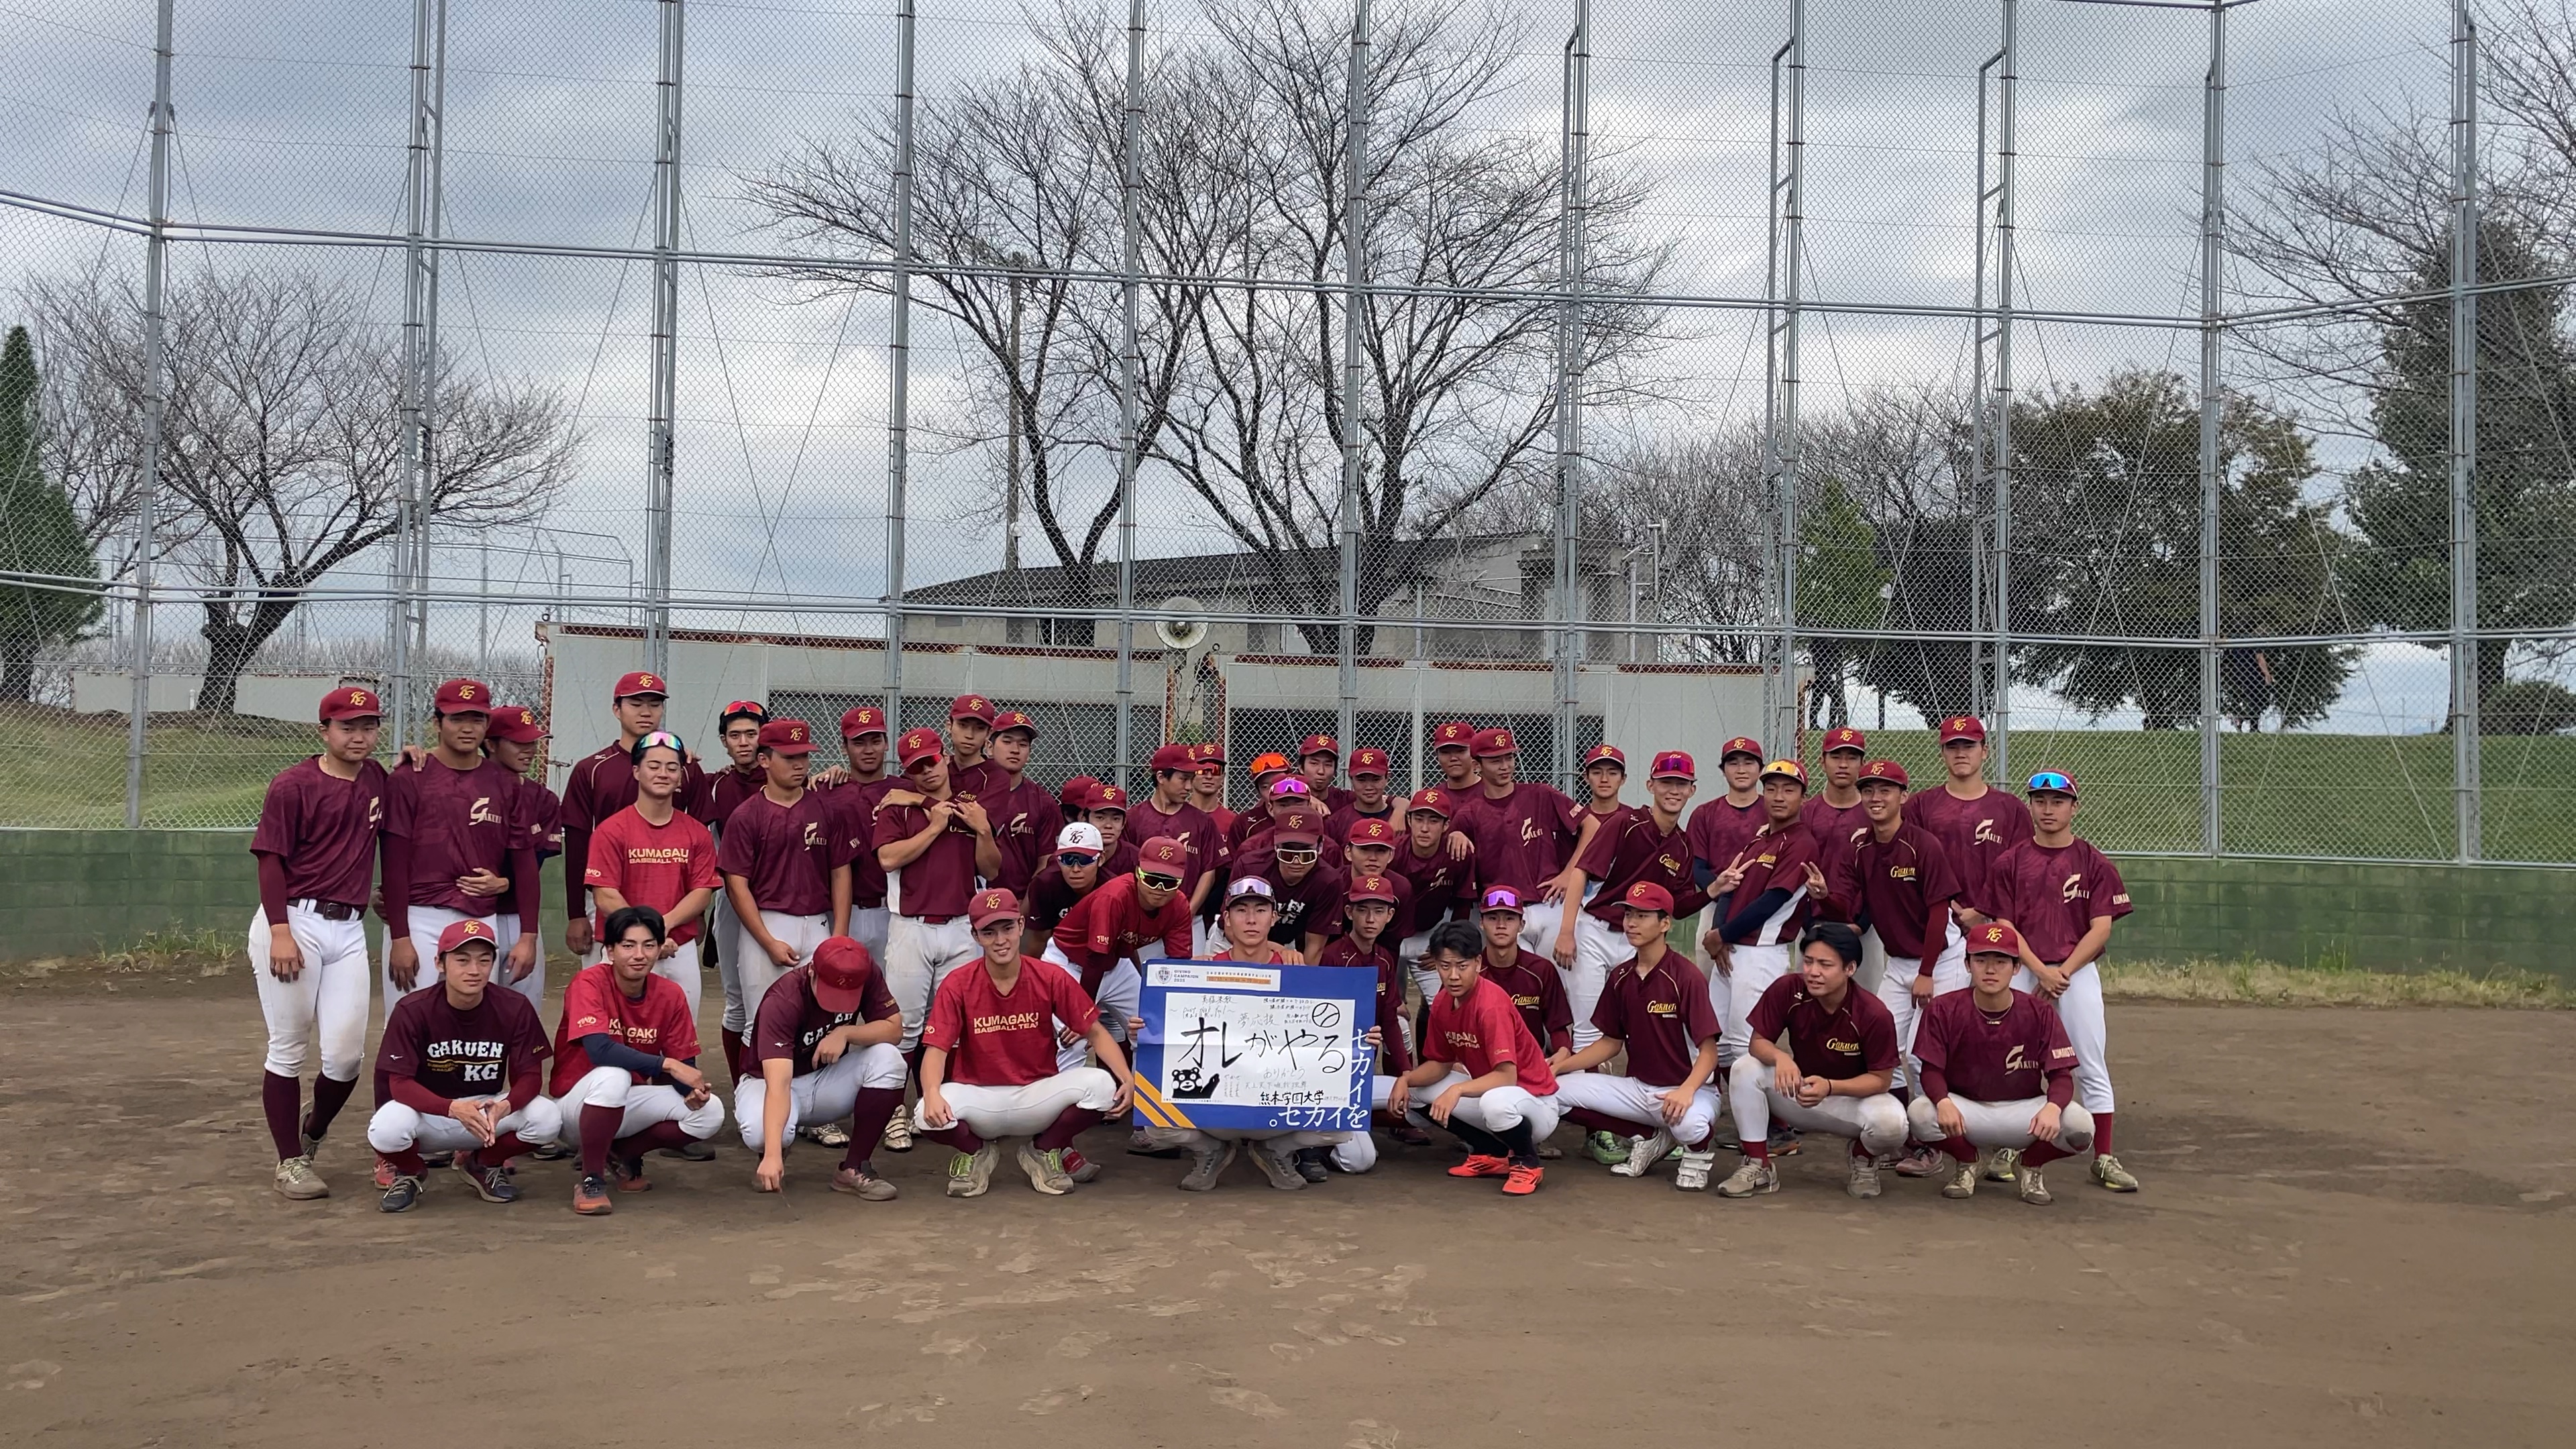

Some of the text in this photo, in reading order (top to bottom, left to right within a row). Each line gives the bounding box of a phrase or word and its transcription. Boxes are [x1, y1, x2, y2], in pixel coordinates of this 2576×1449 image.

[640, 674, 653, 688] KG
[350, 691, 367, 706] KG
[460, 685, 475, 700] KG
[969, 699, 983, 711] KG
[858, 710, 871, 724] KG
[1953, 718, 1966, 731] KG
[909, 735, 921, 749] KG
[1361, 752, 1373, 765] KG
[1103, 788, 1116, 800] KG
[1426, 791, 1438, 803] KG
[1288, 816, 1302, 828] KG
[1368, 823, 1383, 837] KG
[1069, 831, 1084, 844] KG
[1158, 846, 1173, 860] KG
[1366, 877, 1379, 891] KG
[987, 895, 1001, 908] KG
[465, 920, 480, 934] KG
[1986, 927, 2002, 942] KG
[974, 1024, 1017, 1034] BASEBALL
[427, 1040, 504, 1058] GAKUEN
[1178, 1017, 1345, 1074] オレがやる
[464, 1063, 498, 1081] KG
